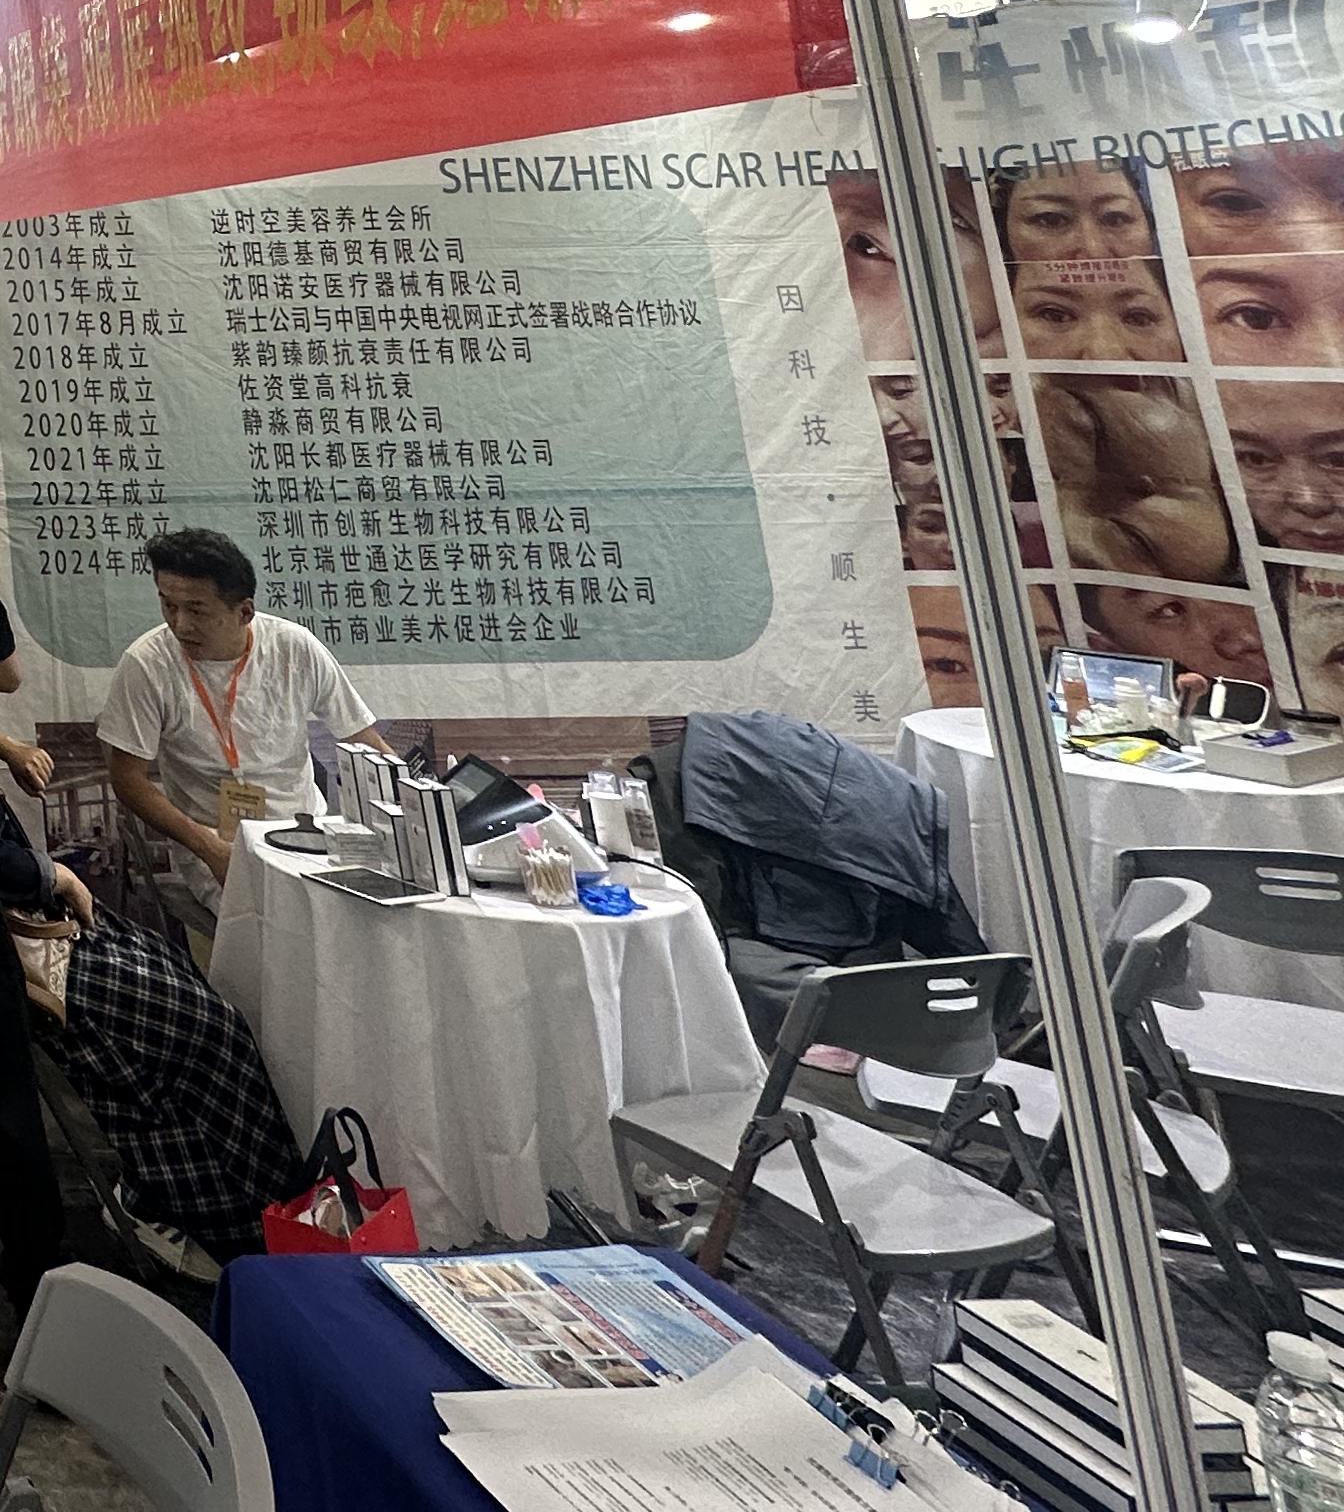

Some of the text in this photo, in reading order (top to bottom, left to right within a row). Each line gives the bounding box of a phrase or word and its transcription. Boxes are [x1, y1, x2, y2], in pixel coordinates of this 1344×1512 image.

[439, 152, 653, 196] SHENZHEN
[662, 150, 765, 190] SCAR
[1092, 109, 1344, 175] BIOTECHN
[210, 204, 432, 235] 逆时空美容养生会所
[3, 237, 466, 272] 2014年成立 沈阳德基商贸有限公司
[7, 269, 523, 304] 2015年成立 沈阳诺安医疗器械有限公司
[11, 298, 702, 338] 2017年8月成立 瑞士公司与中国中央电视网正式签署战略合作协议
[13, 342, 150, 371] 2018年成立
[18, 370, 414, 406] 2019年成立 佐资堂高科抗衰
[22, 409, 161, 439] 2020年成立
[27, 438, 555, 473] 2021年成立 沈阳长都医疗器械有限公司
[31, 473, 508, 507] 2022年成立 沈阳松仁商贸有限公司
[35, 505, 592, 542] 2023年成立 深圳市创新生物科技有限公司
[39, 541, 625, 577] 2024年成 北京瑞世通达医学研究有限公司
[265, 576, 658, 610] 深圳市疤愈之光生物科技有限公司
[296, 612, 582, 645] 市商业美术促进会企业
